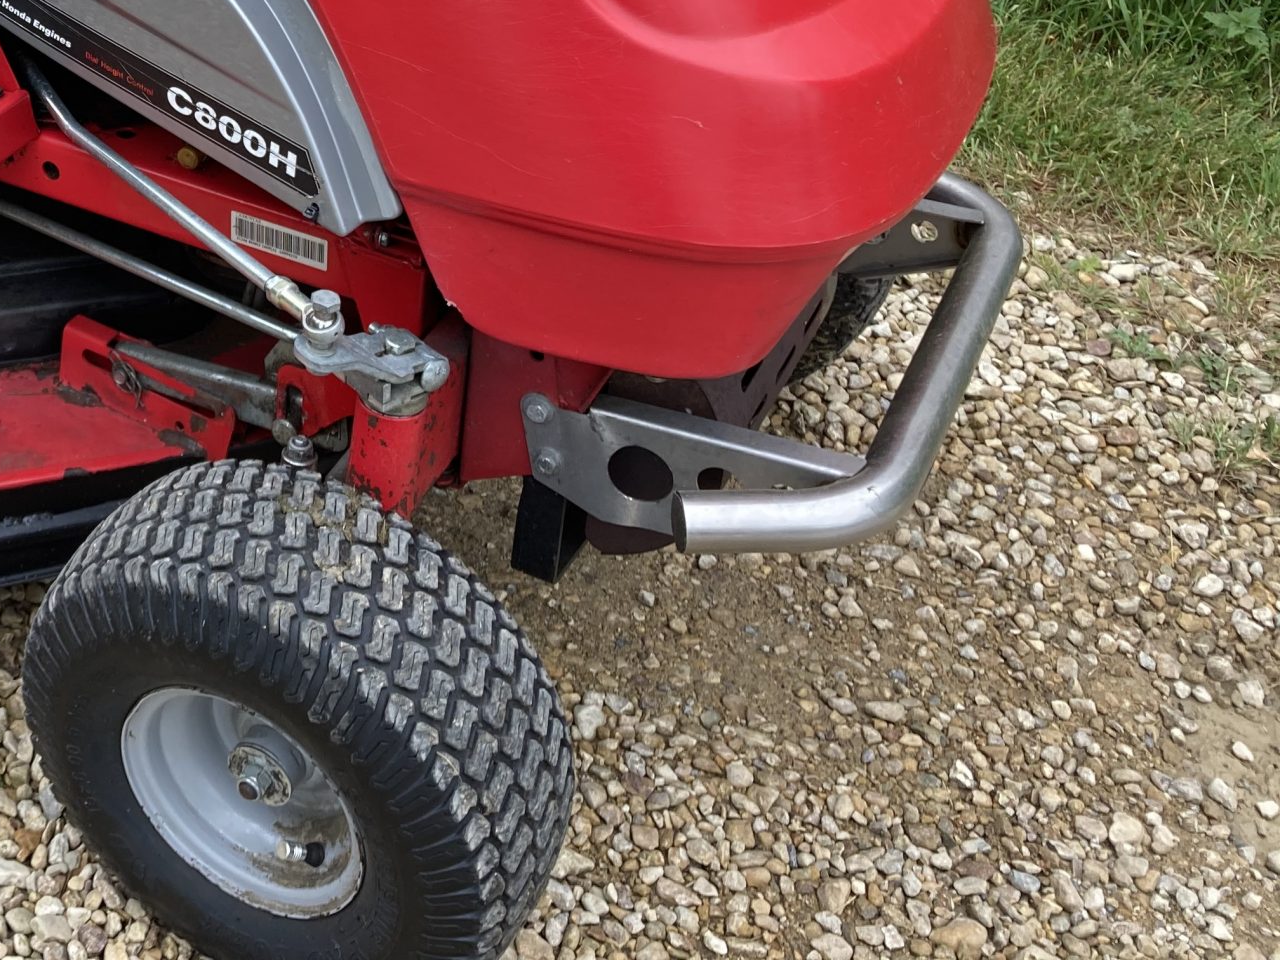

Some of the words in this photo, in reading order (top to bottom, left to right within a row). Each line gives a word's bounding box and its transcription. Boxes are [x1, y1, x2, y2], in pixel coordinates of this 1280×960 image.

[2, 0, 32, 24] Honda
[33, 18, 72, 48] Engines
[167, 86, 298, 178] C800H
